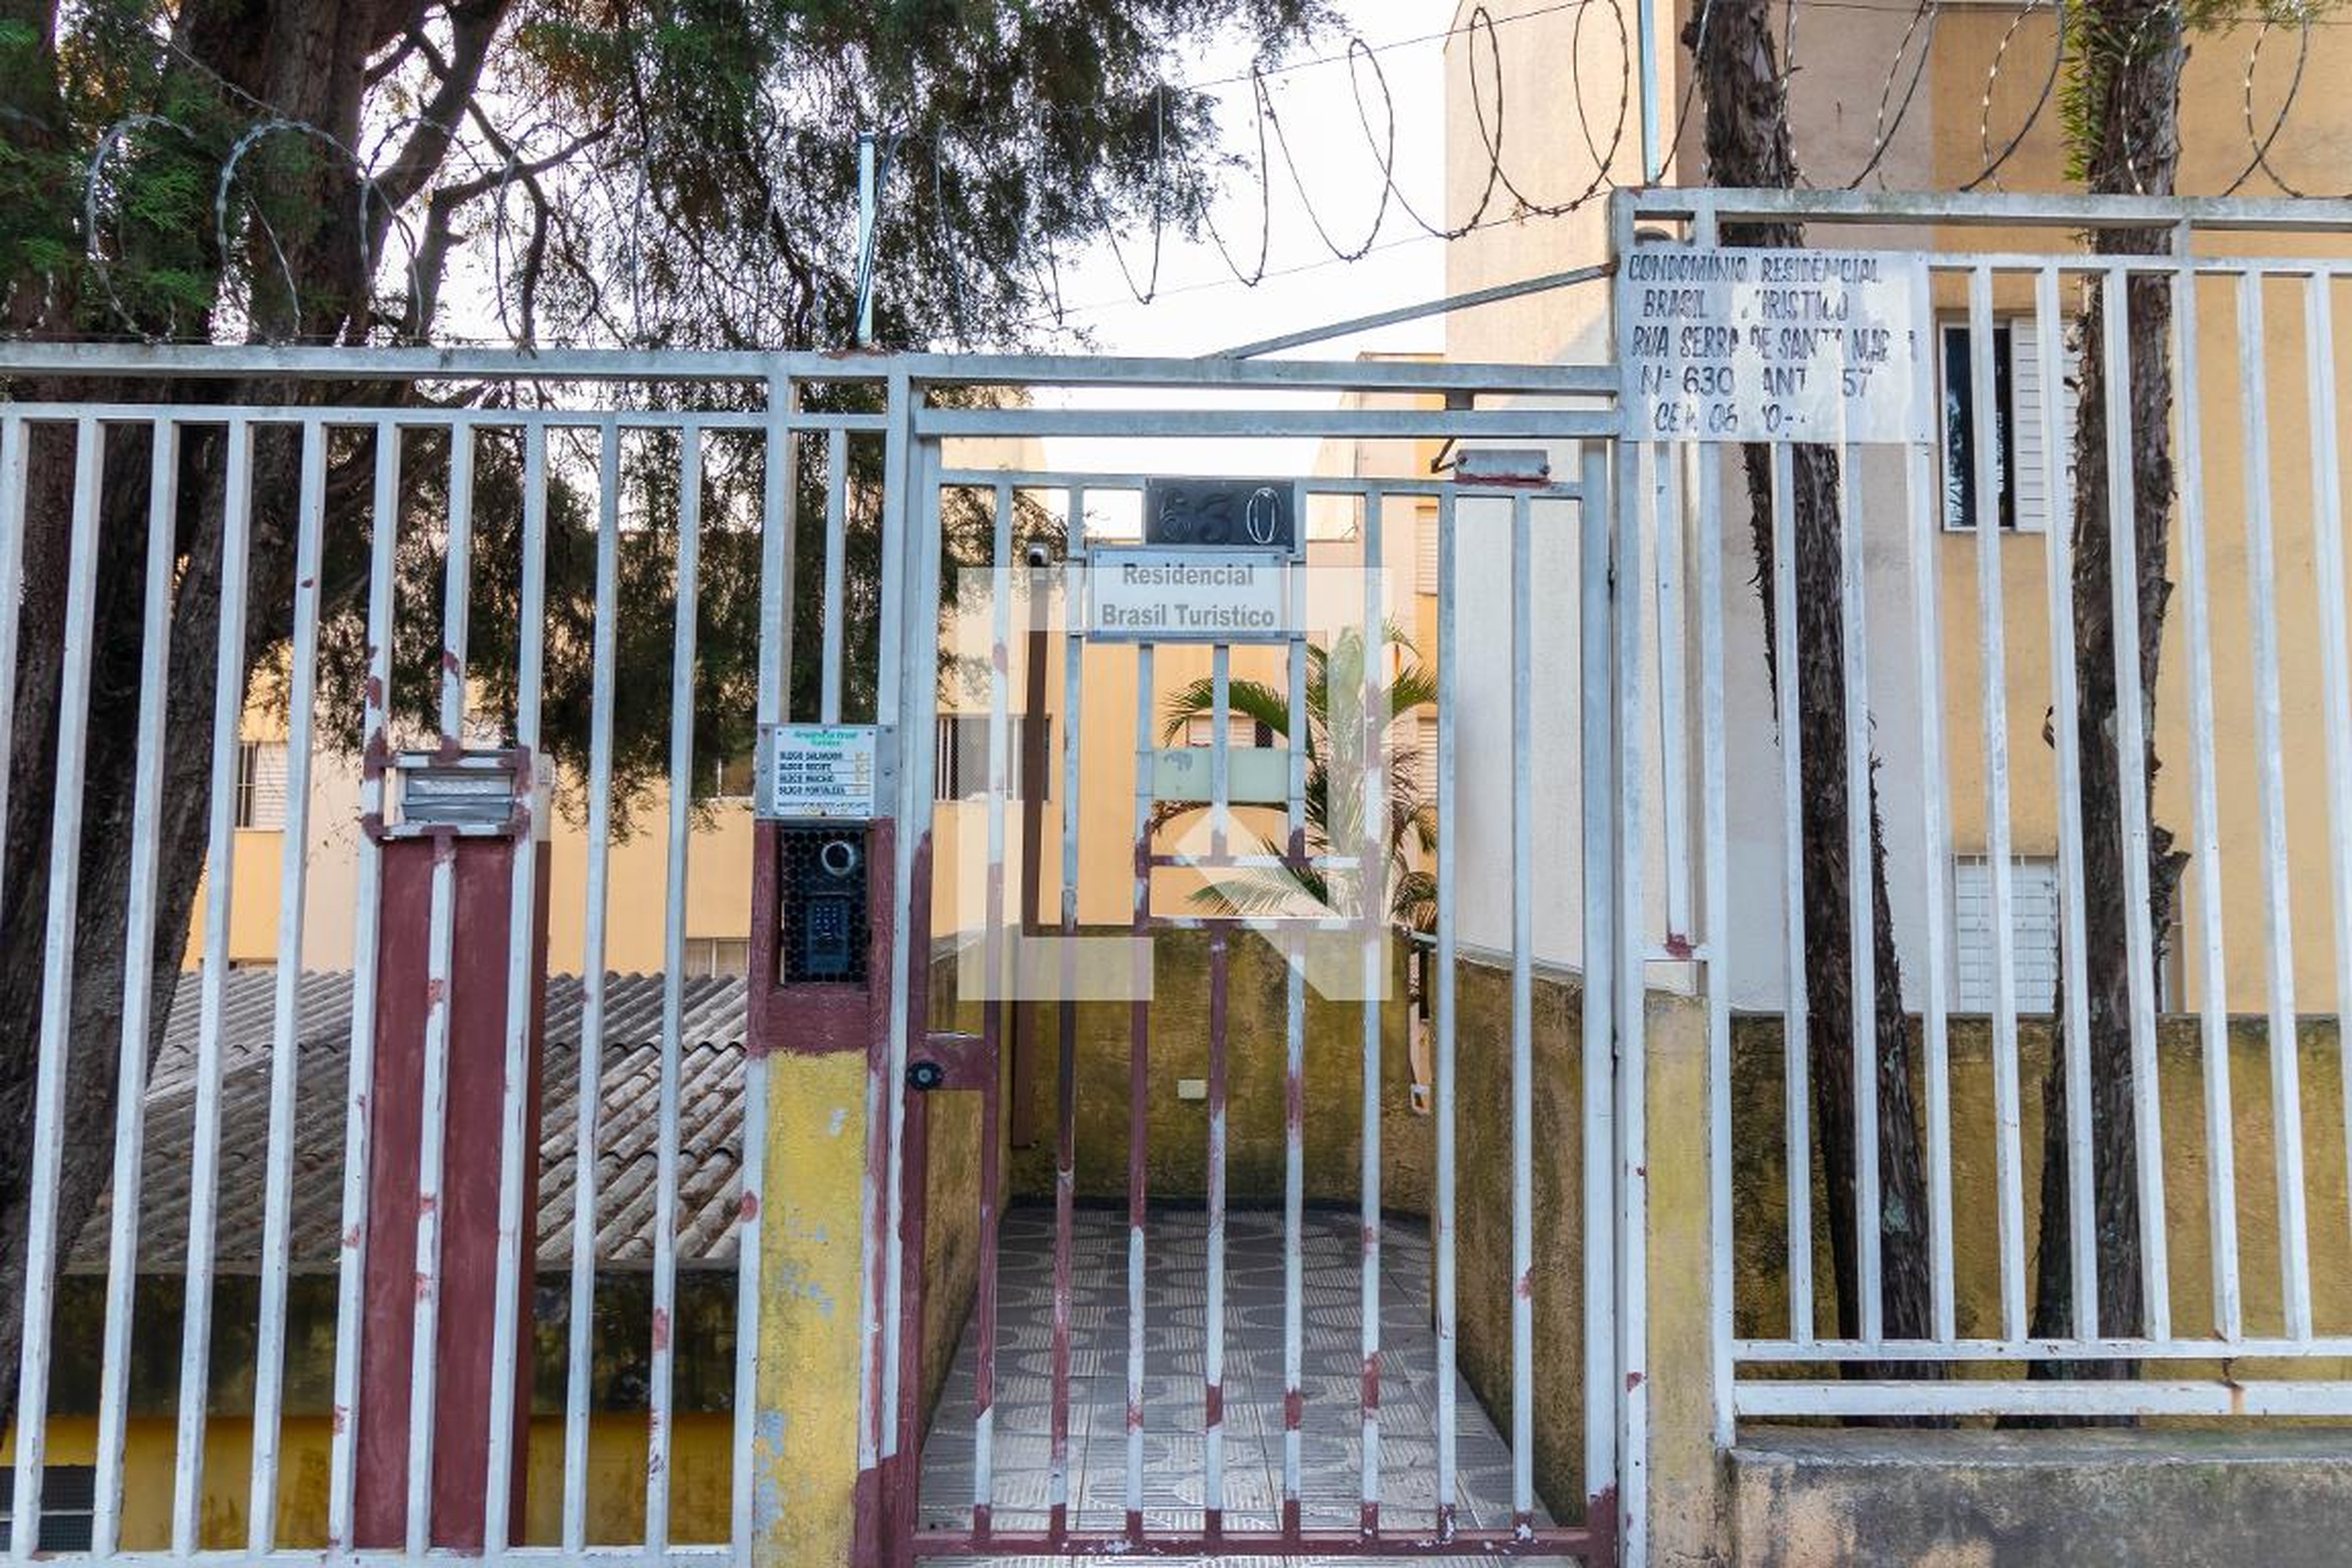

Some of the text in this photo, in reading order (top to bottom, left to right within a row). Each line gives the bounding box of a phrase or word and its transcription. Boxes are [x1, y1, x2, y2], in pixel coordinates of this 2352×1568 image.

[1632, 325, 1669, 358] RUA
[1683, 366, 1735, 397] 630
[1122, 562, 1254, 586] Residencial
[1102, 603, 1167, 626] Brasil
